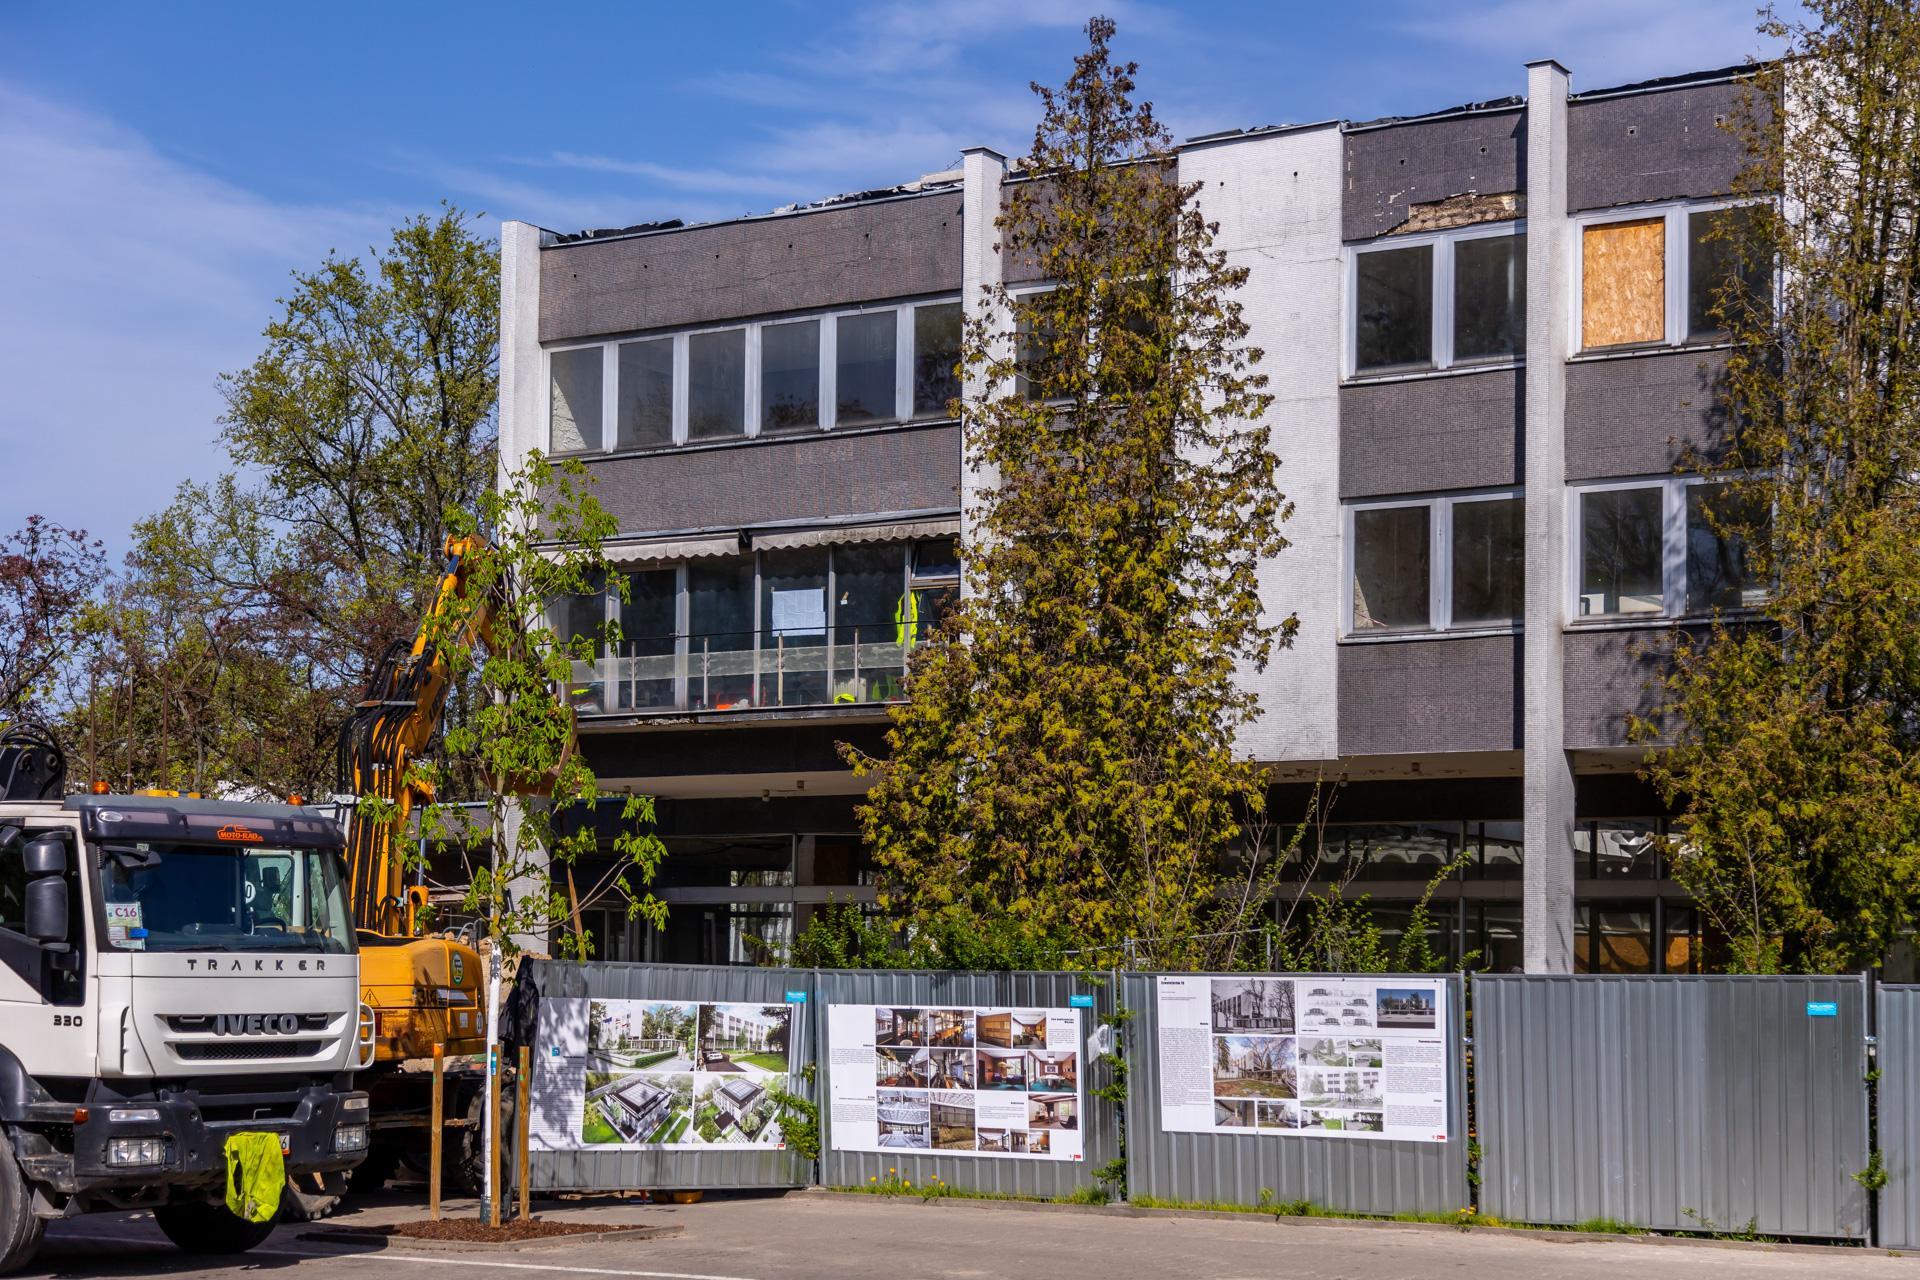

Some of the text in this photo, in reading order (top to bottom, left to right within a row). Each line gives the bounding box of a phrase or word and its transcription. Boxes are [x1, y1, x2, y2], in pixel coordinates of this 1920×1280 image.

[220, 831, 258, 840] MOTO-RAD
[115, 907, 137, 918] C16
[187, 959, 325, 971] TRAKKER
[53, 1014, 83, 1027] 330
[214, 1014, 298, 1036] IVECO
